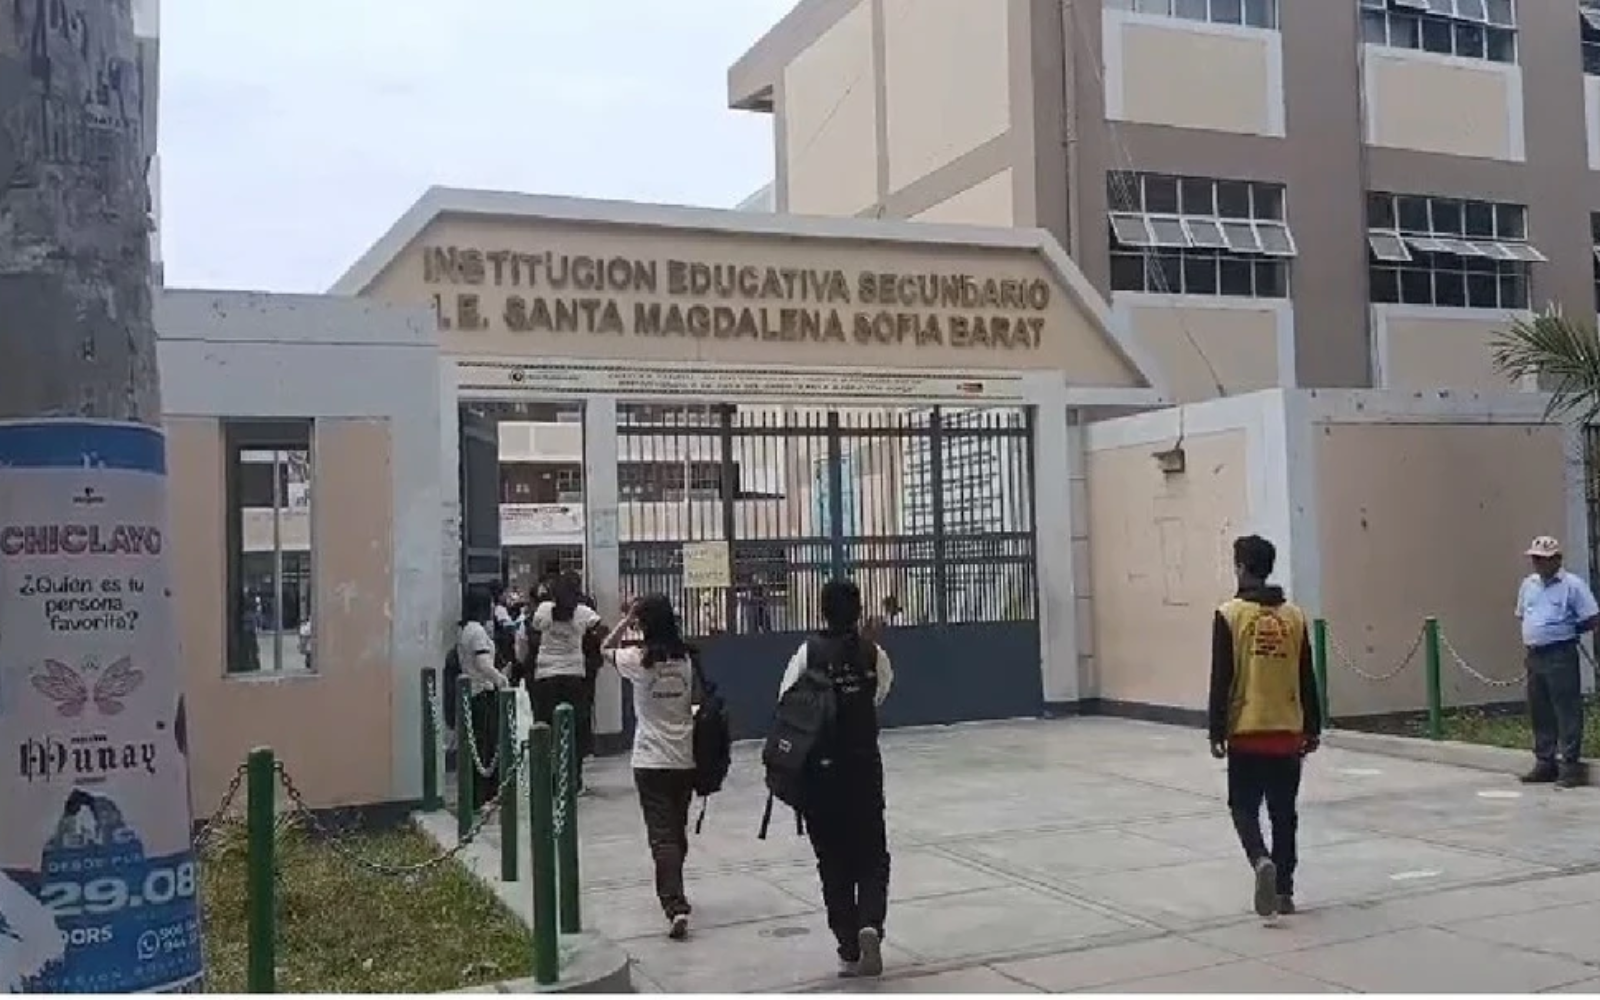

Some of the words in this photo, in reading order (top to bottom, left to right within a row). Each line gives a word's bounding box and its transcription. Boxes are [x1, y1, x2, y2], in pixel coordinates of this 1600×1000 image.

[424, 246, 657, 292] INSTITUCION
[667, 259, 849, 304] EDUCATIVA
[858, 271, 1049, 310] SECUNDARIO
[503, 296, 623, 335] SANTA
[634, 303, 846, 342] MAGDALENA
[853, 312, 943, 346] SOFIA
[949, 316, 1045, 349] BARAT
[1, 524, 162, 556] CHICLAYO
[101, 579, 121, 593] es
[129, 578, 144, 593] tu
[45, 598, 122, 618] persona
[51, 610, 138, 631] favorita?
[41, 862, 195, 916] 29.08
